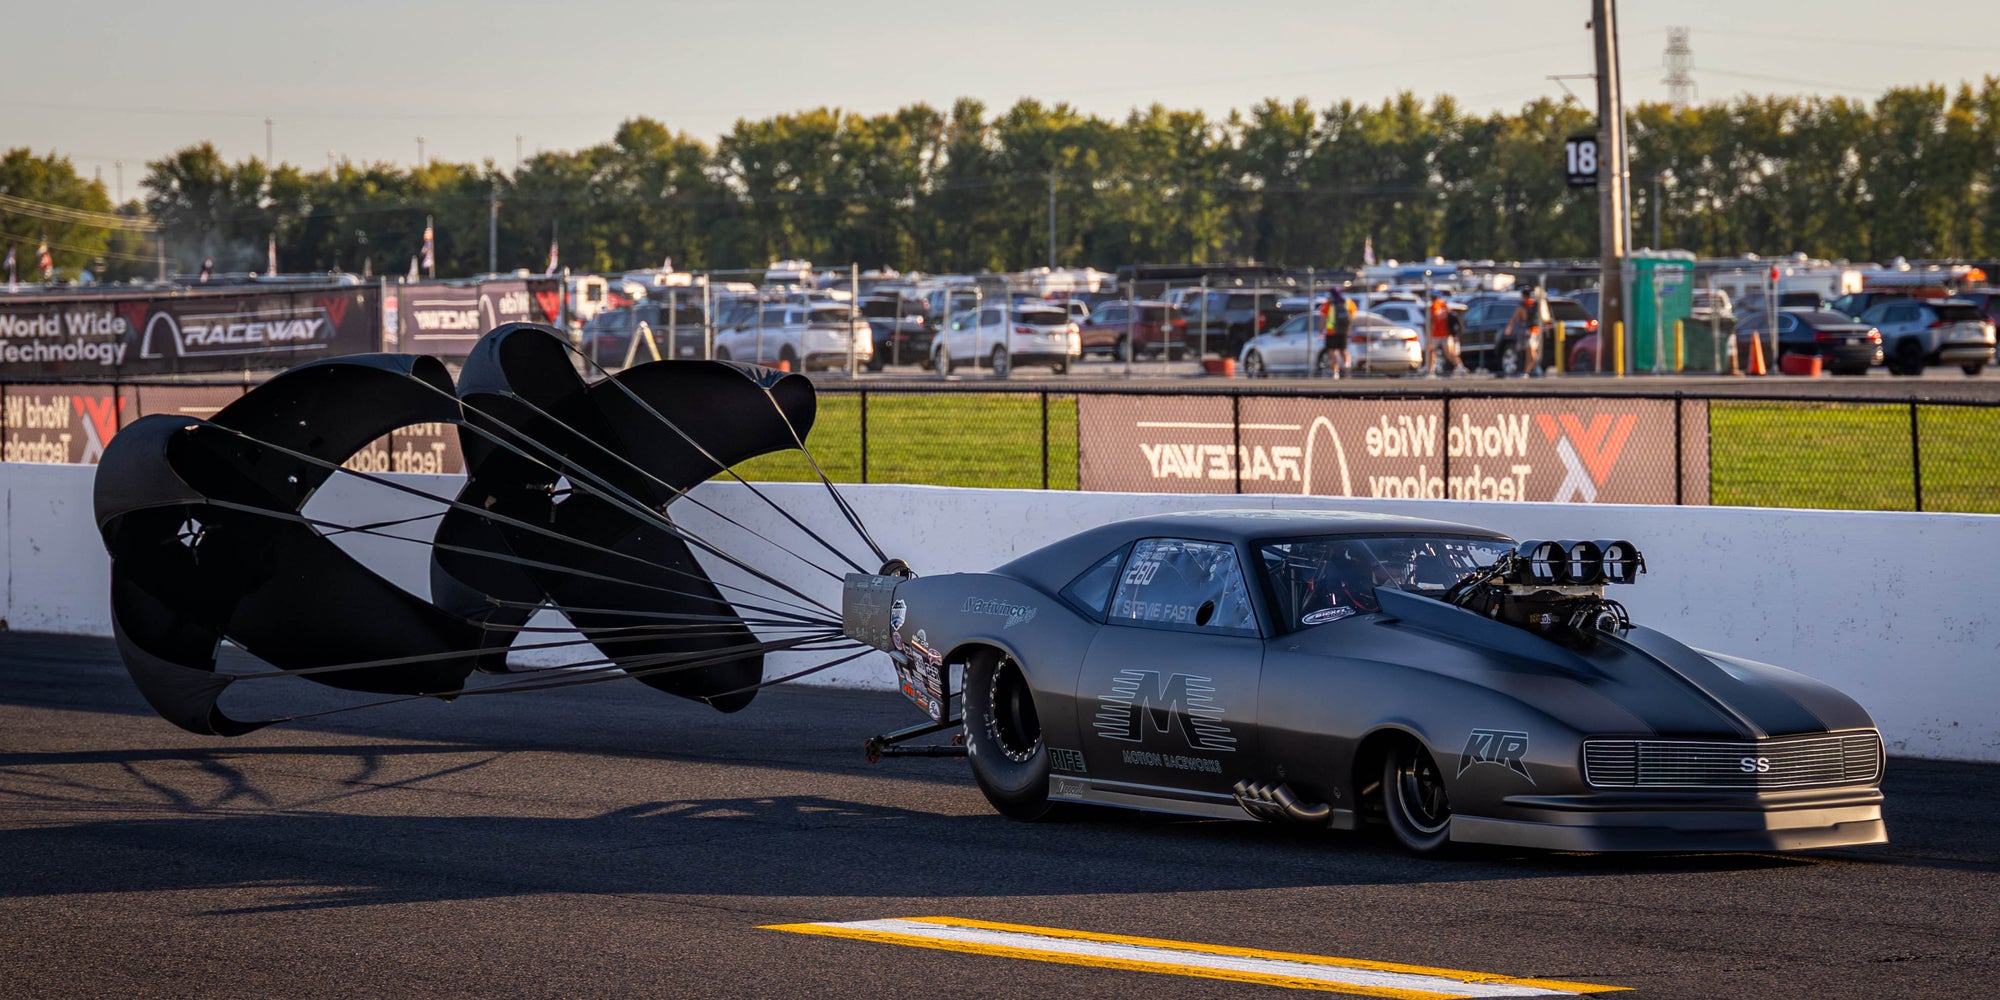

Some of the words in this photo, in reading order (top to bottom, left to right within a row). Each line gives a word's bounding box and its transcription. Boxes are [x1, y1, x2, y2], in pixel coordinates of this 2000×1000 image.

[1565, 141, 1597, 174] 18
[64, 311, 127, 335] Wide
[182, 318, 325, 346] RACEWAY
[1125, 561, 1160, 585] 280
[1122, 600, 1162, 618] STEVIE
[1163, 602, 1195, 621] FAST
[1051, 749, 1087, 773] RIFE
[1122, 750, 1163, 767] MOTION
[1162, 753, 1223, 774] RACEWORKS
[1456, 727, 1537, 787] KTR
[1740, 757, 1770, 773] SS
